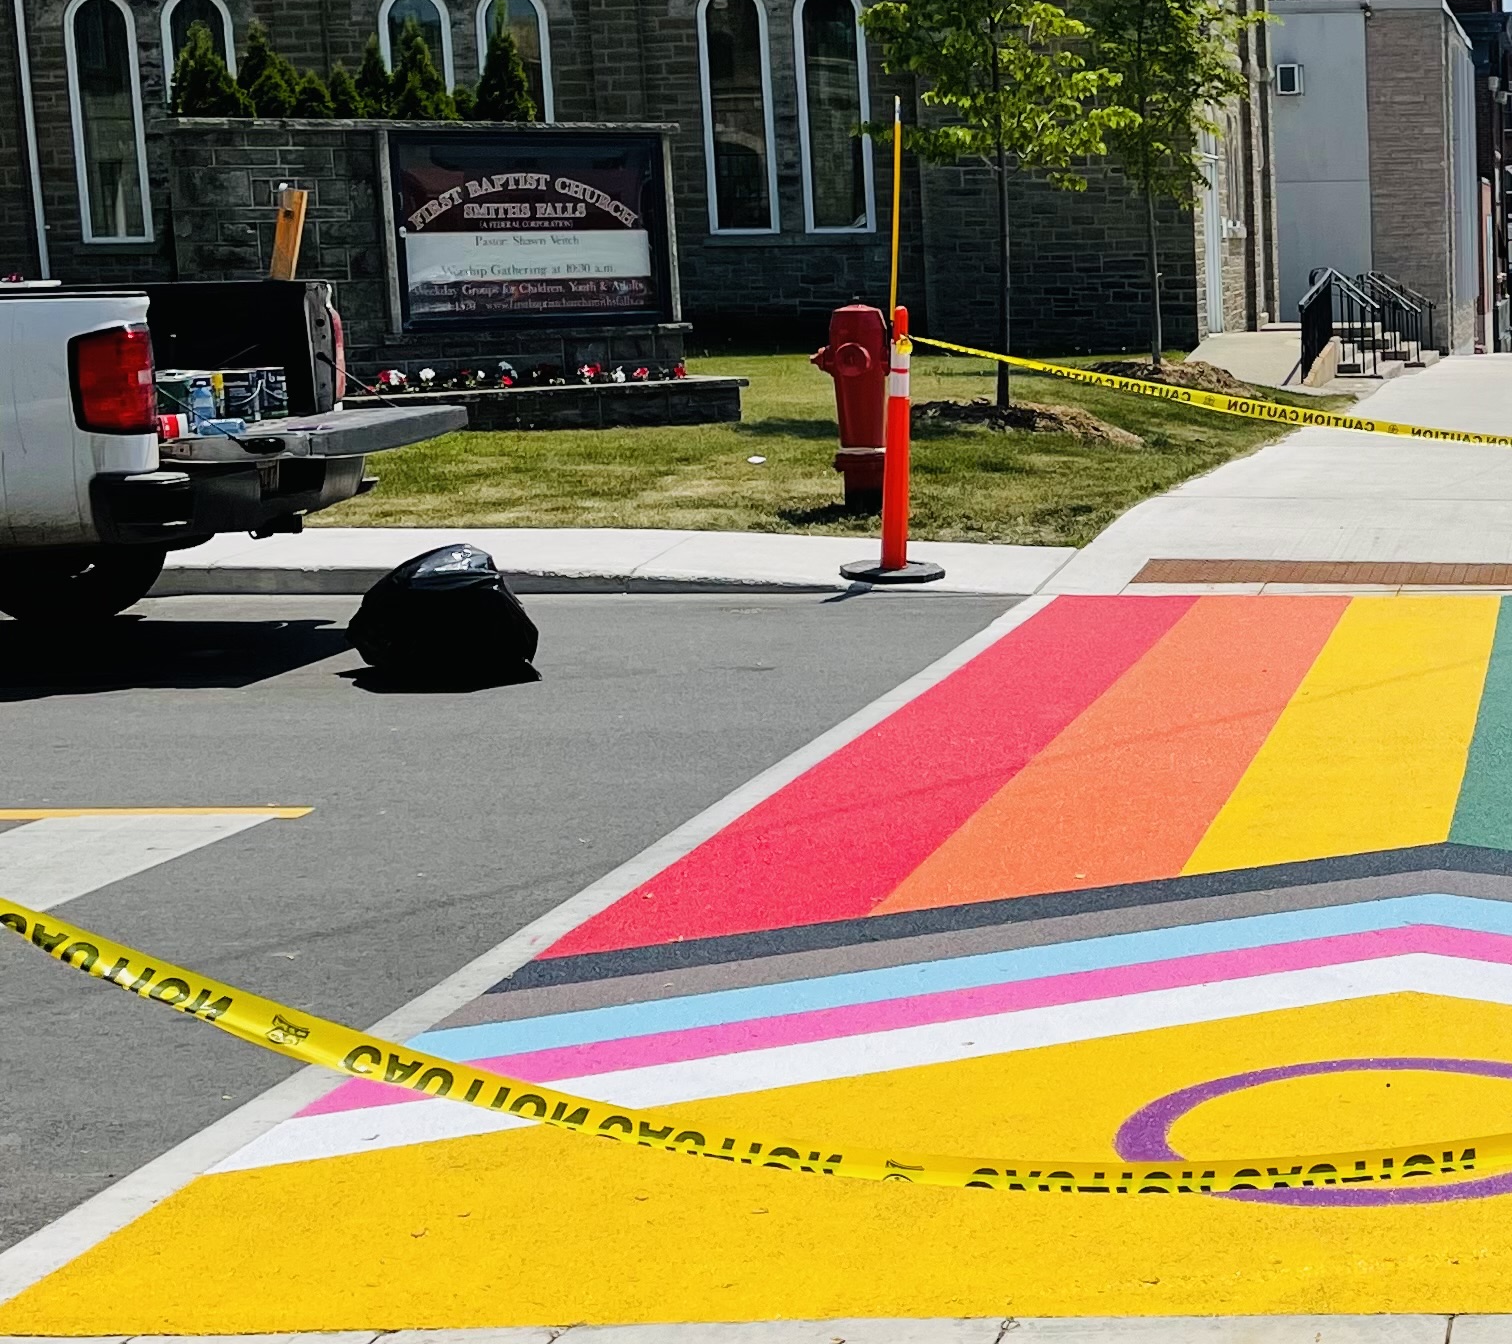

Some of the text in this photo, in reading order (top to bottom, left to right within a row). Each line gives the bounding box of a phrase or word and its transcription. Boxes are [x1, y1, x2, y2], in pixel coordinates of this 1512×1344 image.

[408, 172, 639, 231] FIRST BAPTIST CHURCH
[463, 202, 587, 219] SMITHS FALLS
[489, 220, 521, 229] FEDERAL
[512, 235, 546, 246] Shawn
[490, 264, 547, 276] Gathering
[552, 264, 561, 273] at
[566, 264, 591, 273] 10:30
[462, 284, 499, 298] Groups
[502, 283, 515, 294] for
[568, 282, 596, 292] Youth
